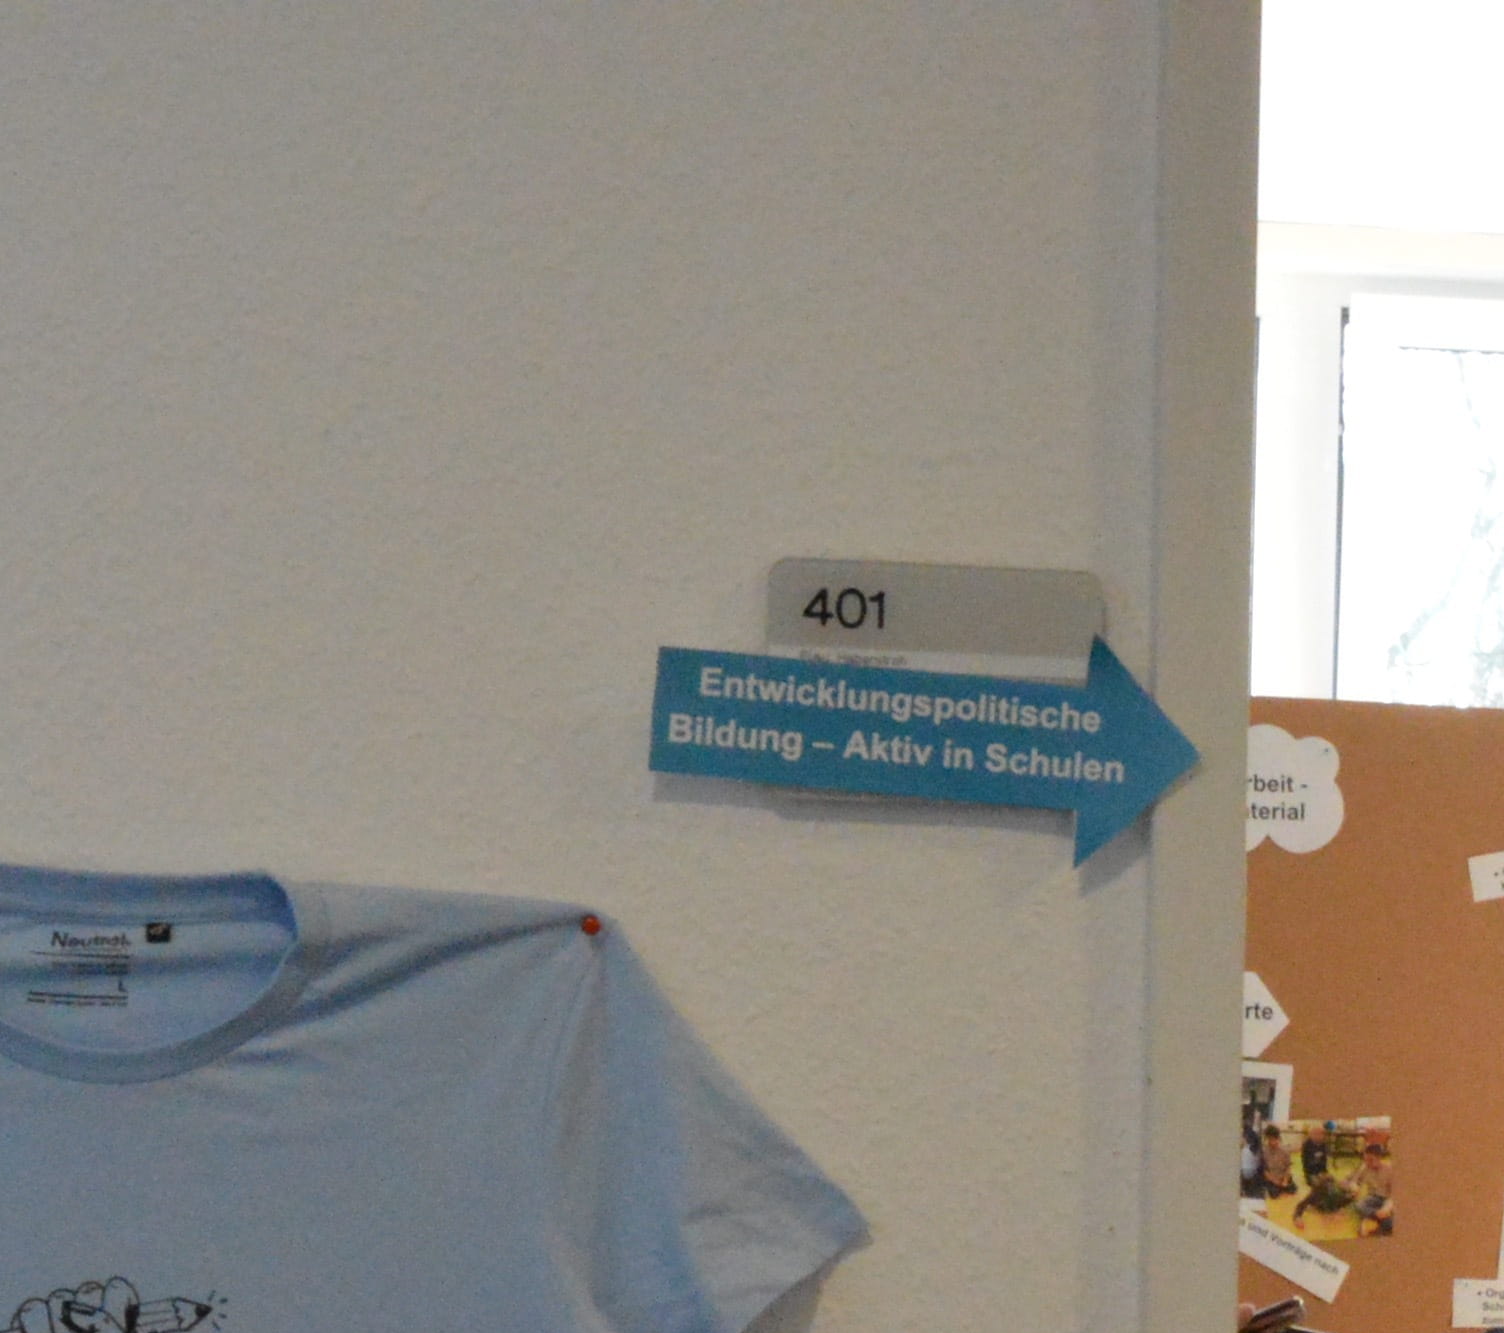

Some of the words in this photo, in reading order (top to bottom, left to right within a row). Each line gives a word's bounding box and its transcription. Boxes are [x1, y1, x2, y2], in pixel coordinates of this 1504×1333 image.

[803, 588, 886, 629] 401
[699, 666, 1101, 733] Entwicklungspolitische
[668, 713, 803, 762] Bildung
[842, 730, 933, 766] Aktiv
[943, 740, 973, 770] in
[984, 743, 1125, 783] Schulen
[1248, 774, 1294, 793] beit
[1248, 802, 1305, 821] terial
